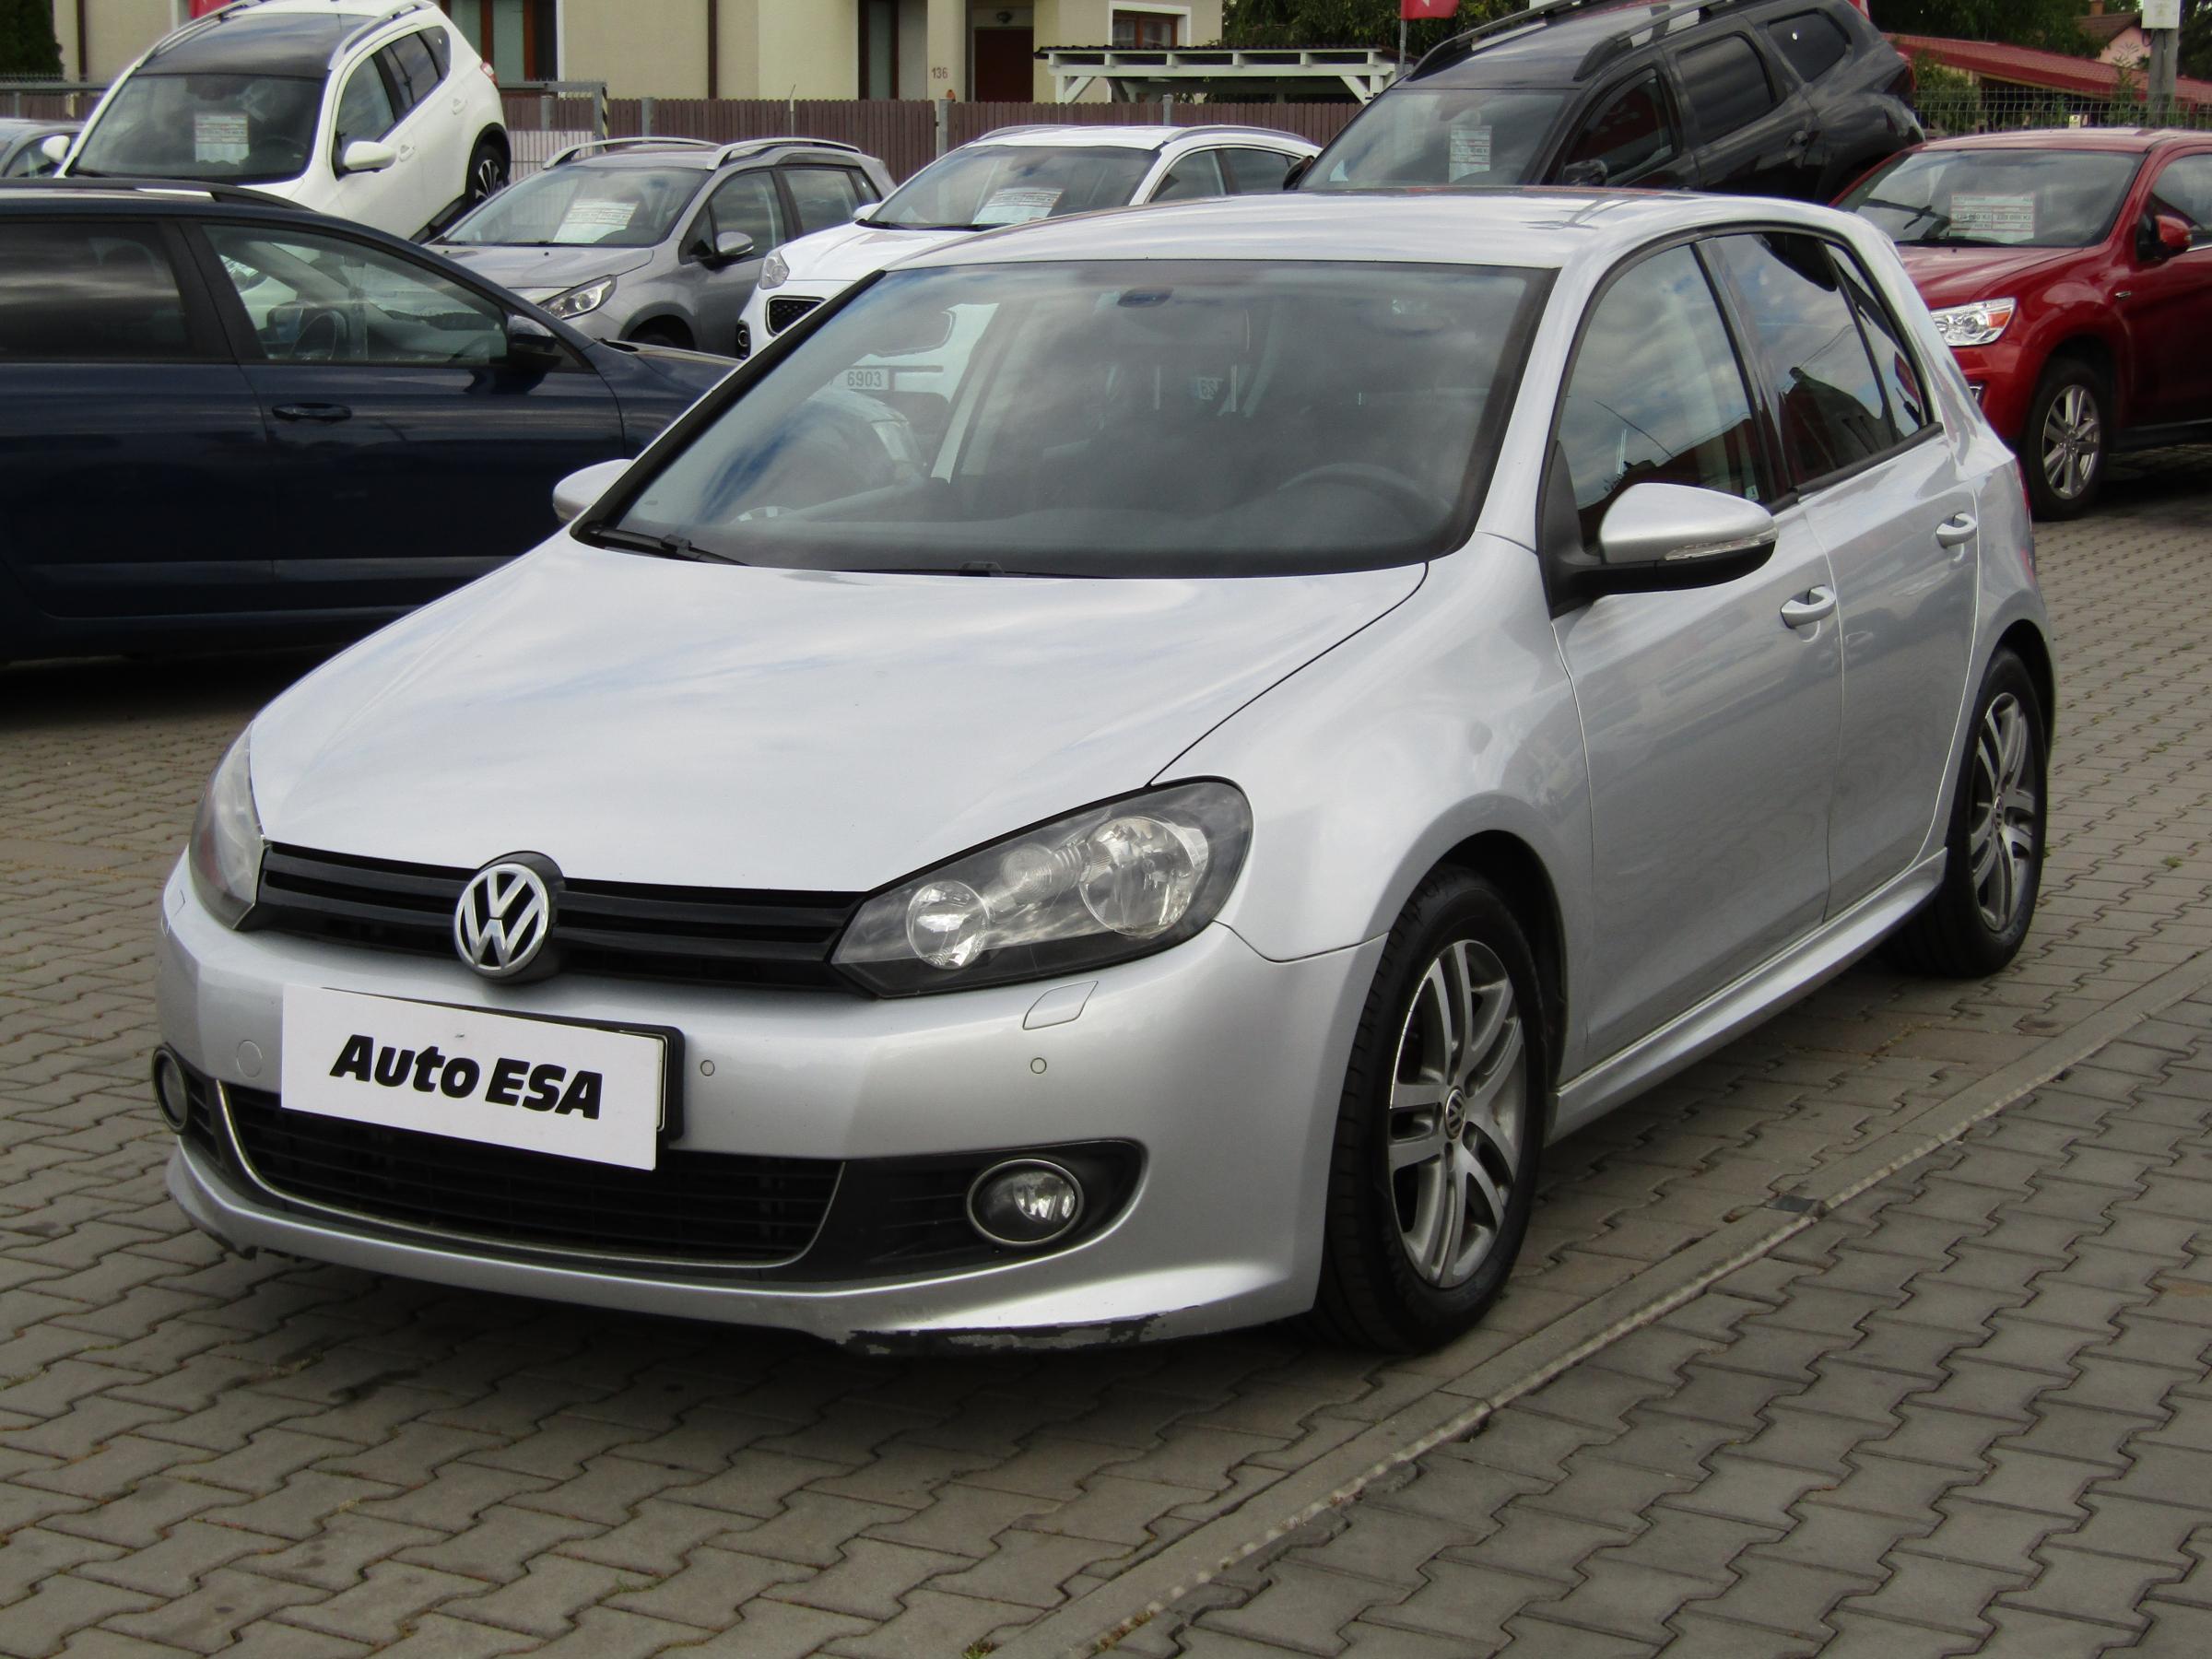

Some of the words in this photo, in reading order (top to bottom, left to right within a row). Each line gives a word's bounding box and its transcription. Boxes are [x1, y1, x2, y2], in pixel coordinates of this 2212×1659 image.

[931, 66, 948, 79] 136
[847, 371, 882, 387] 6903
[458, 865, 547, 971] VW
[329, 1034, 480, 1099] Auto
[485, 1057, 603, 1120] ESA
